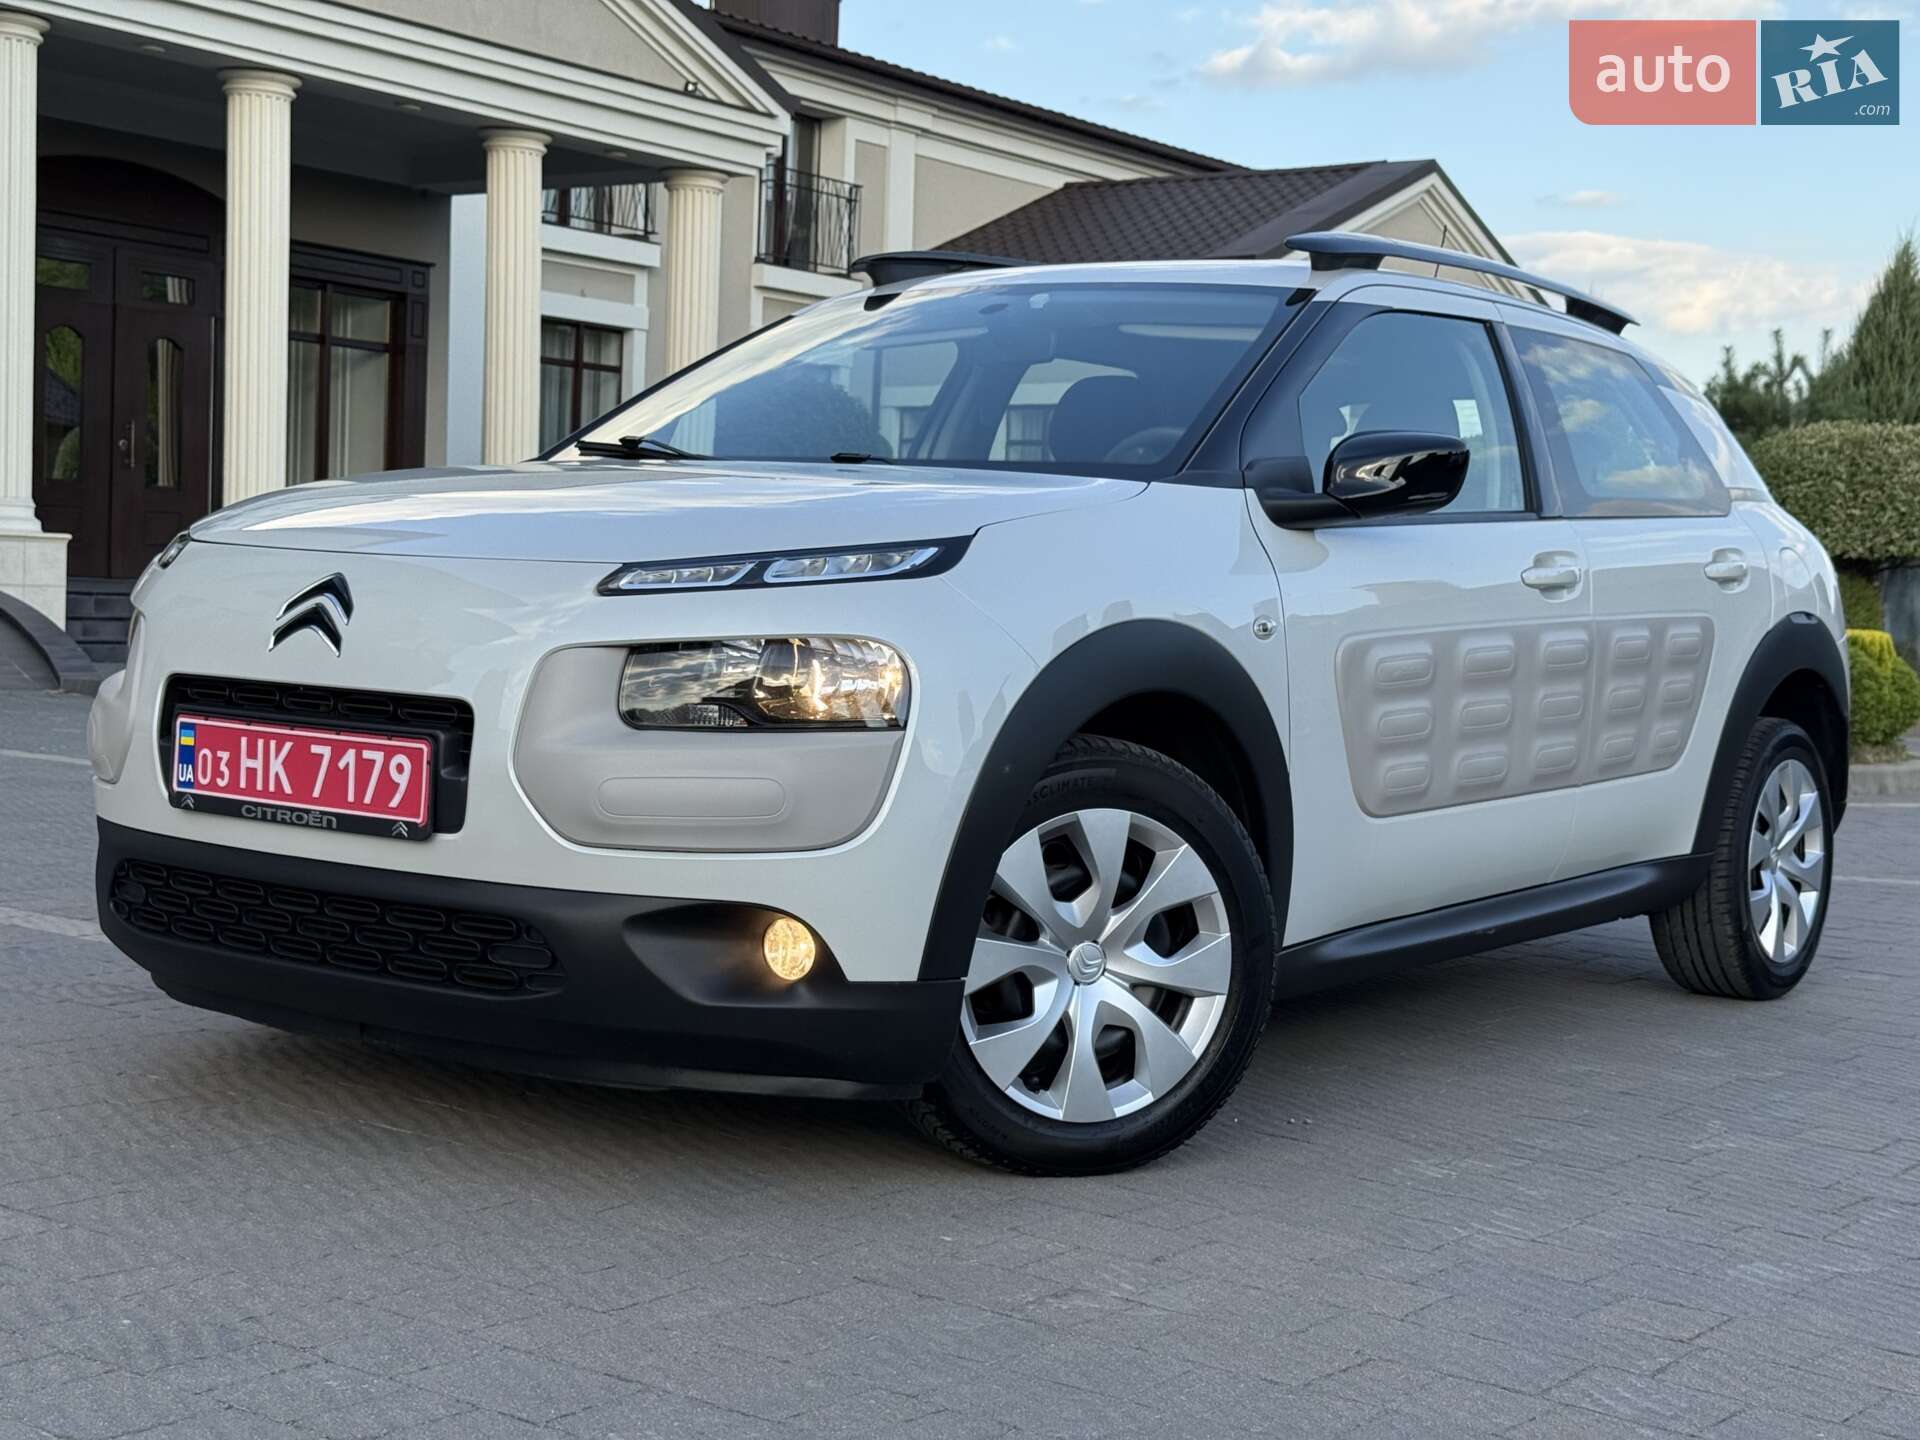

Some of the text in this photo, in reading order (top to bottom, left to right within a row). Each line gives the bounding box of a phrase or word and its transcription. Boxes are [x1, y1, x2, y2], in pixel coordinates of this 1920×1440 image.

[178, 763, 194, 783] UA
[198, 736, 412, 808] 03 HK 7179
